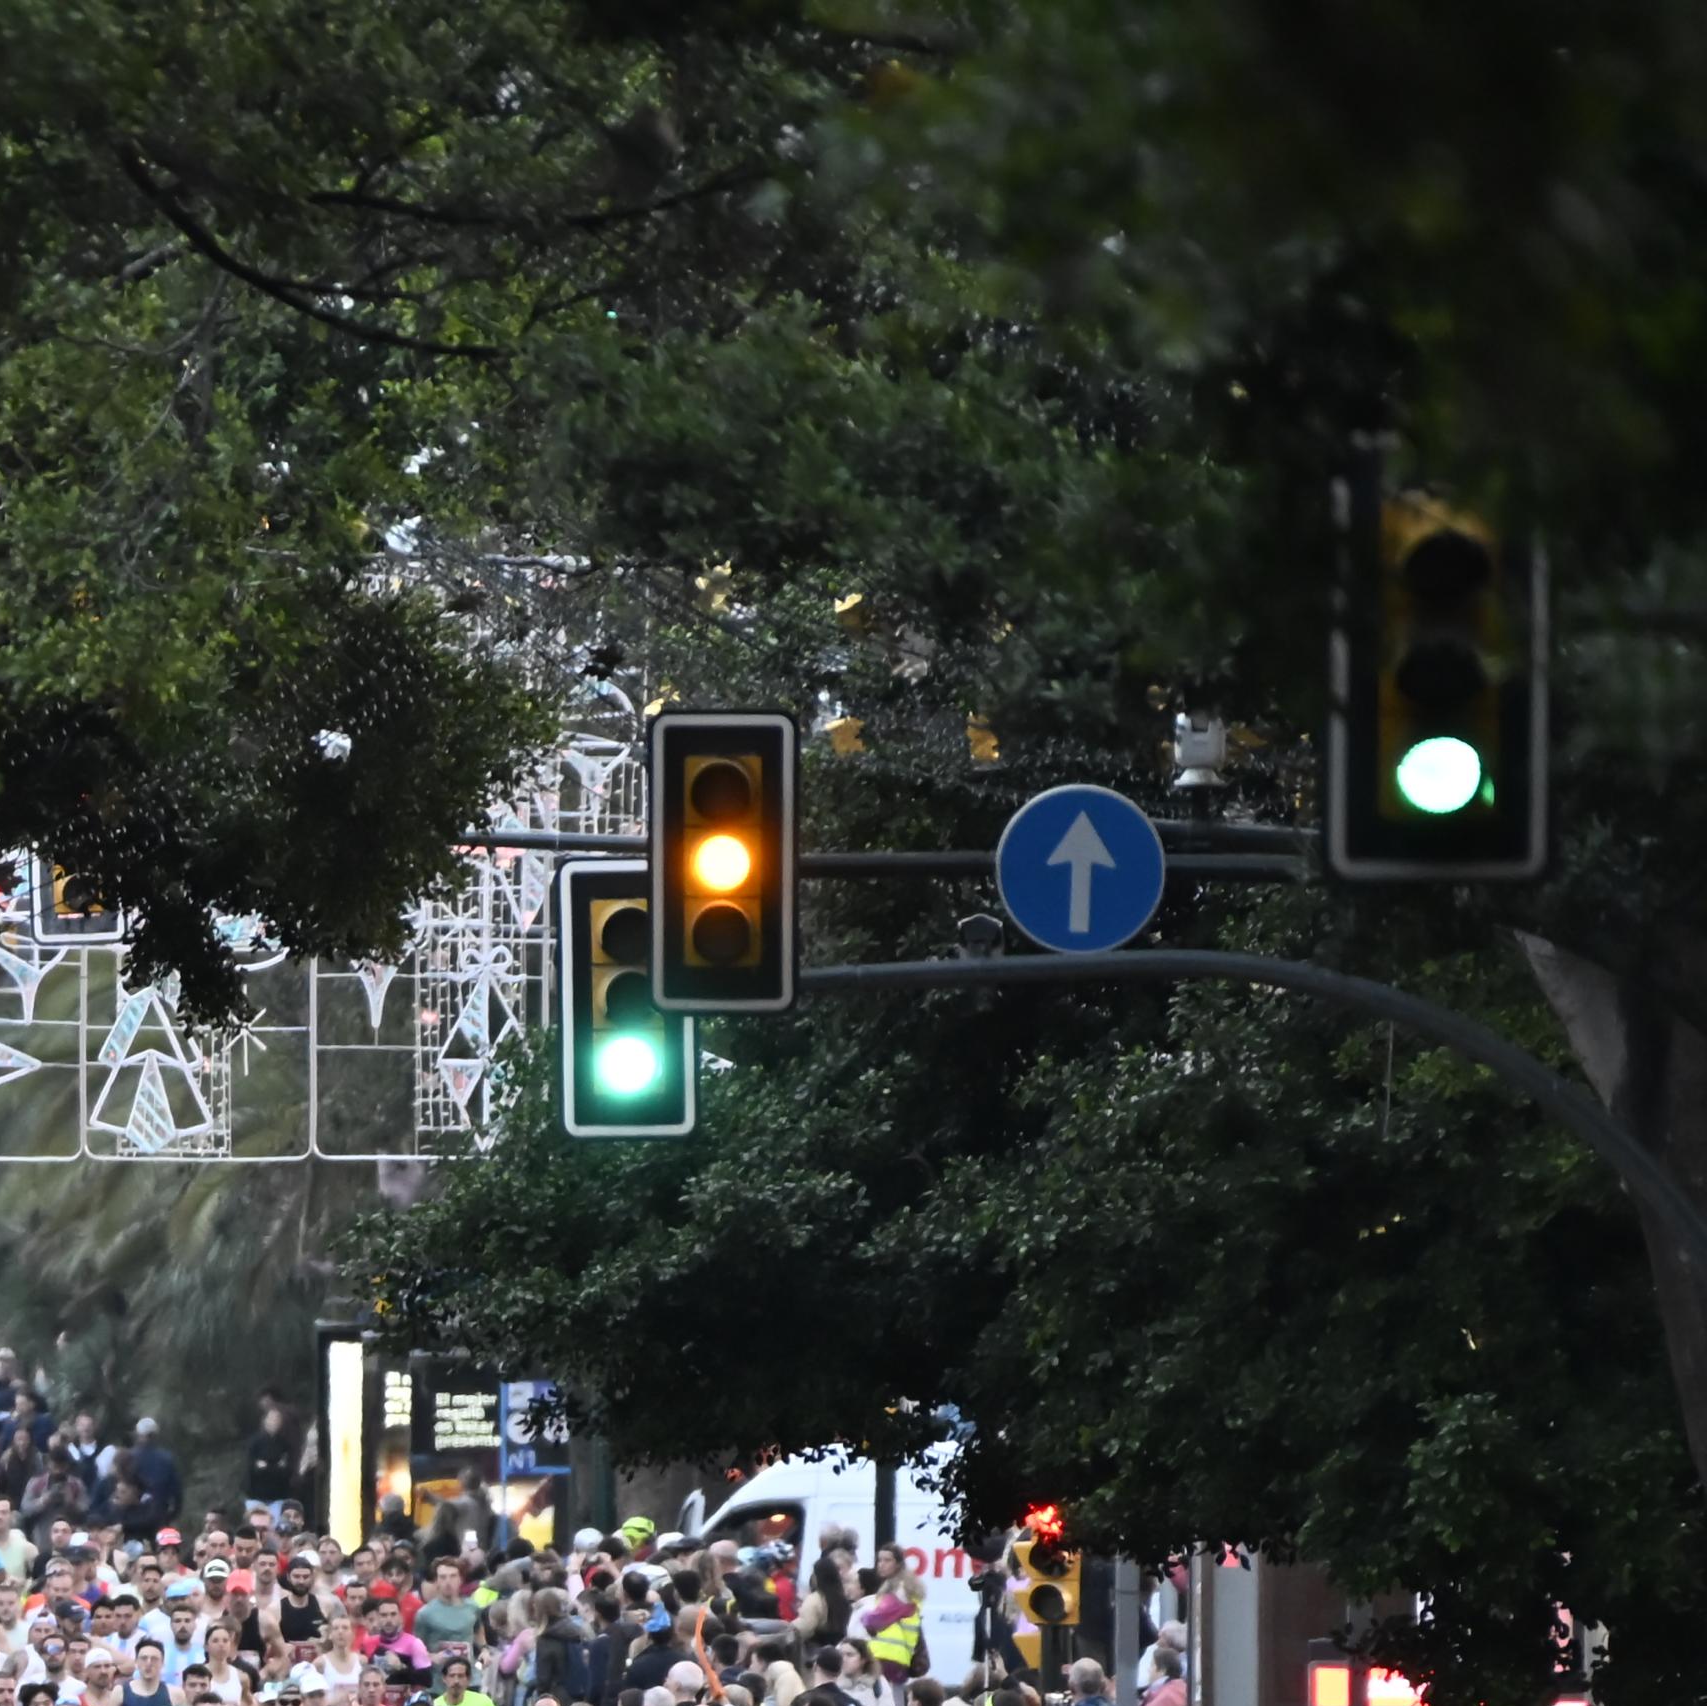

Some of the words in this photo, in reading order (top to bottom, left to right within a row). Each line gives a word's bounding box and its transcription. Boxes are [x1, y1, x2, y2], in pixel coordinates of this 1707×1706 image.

[452, 1392, 498, 1408] mejor
[435, 1406, 485, 1421] regalo
[435, 1433, 503, 1451] presente
